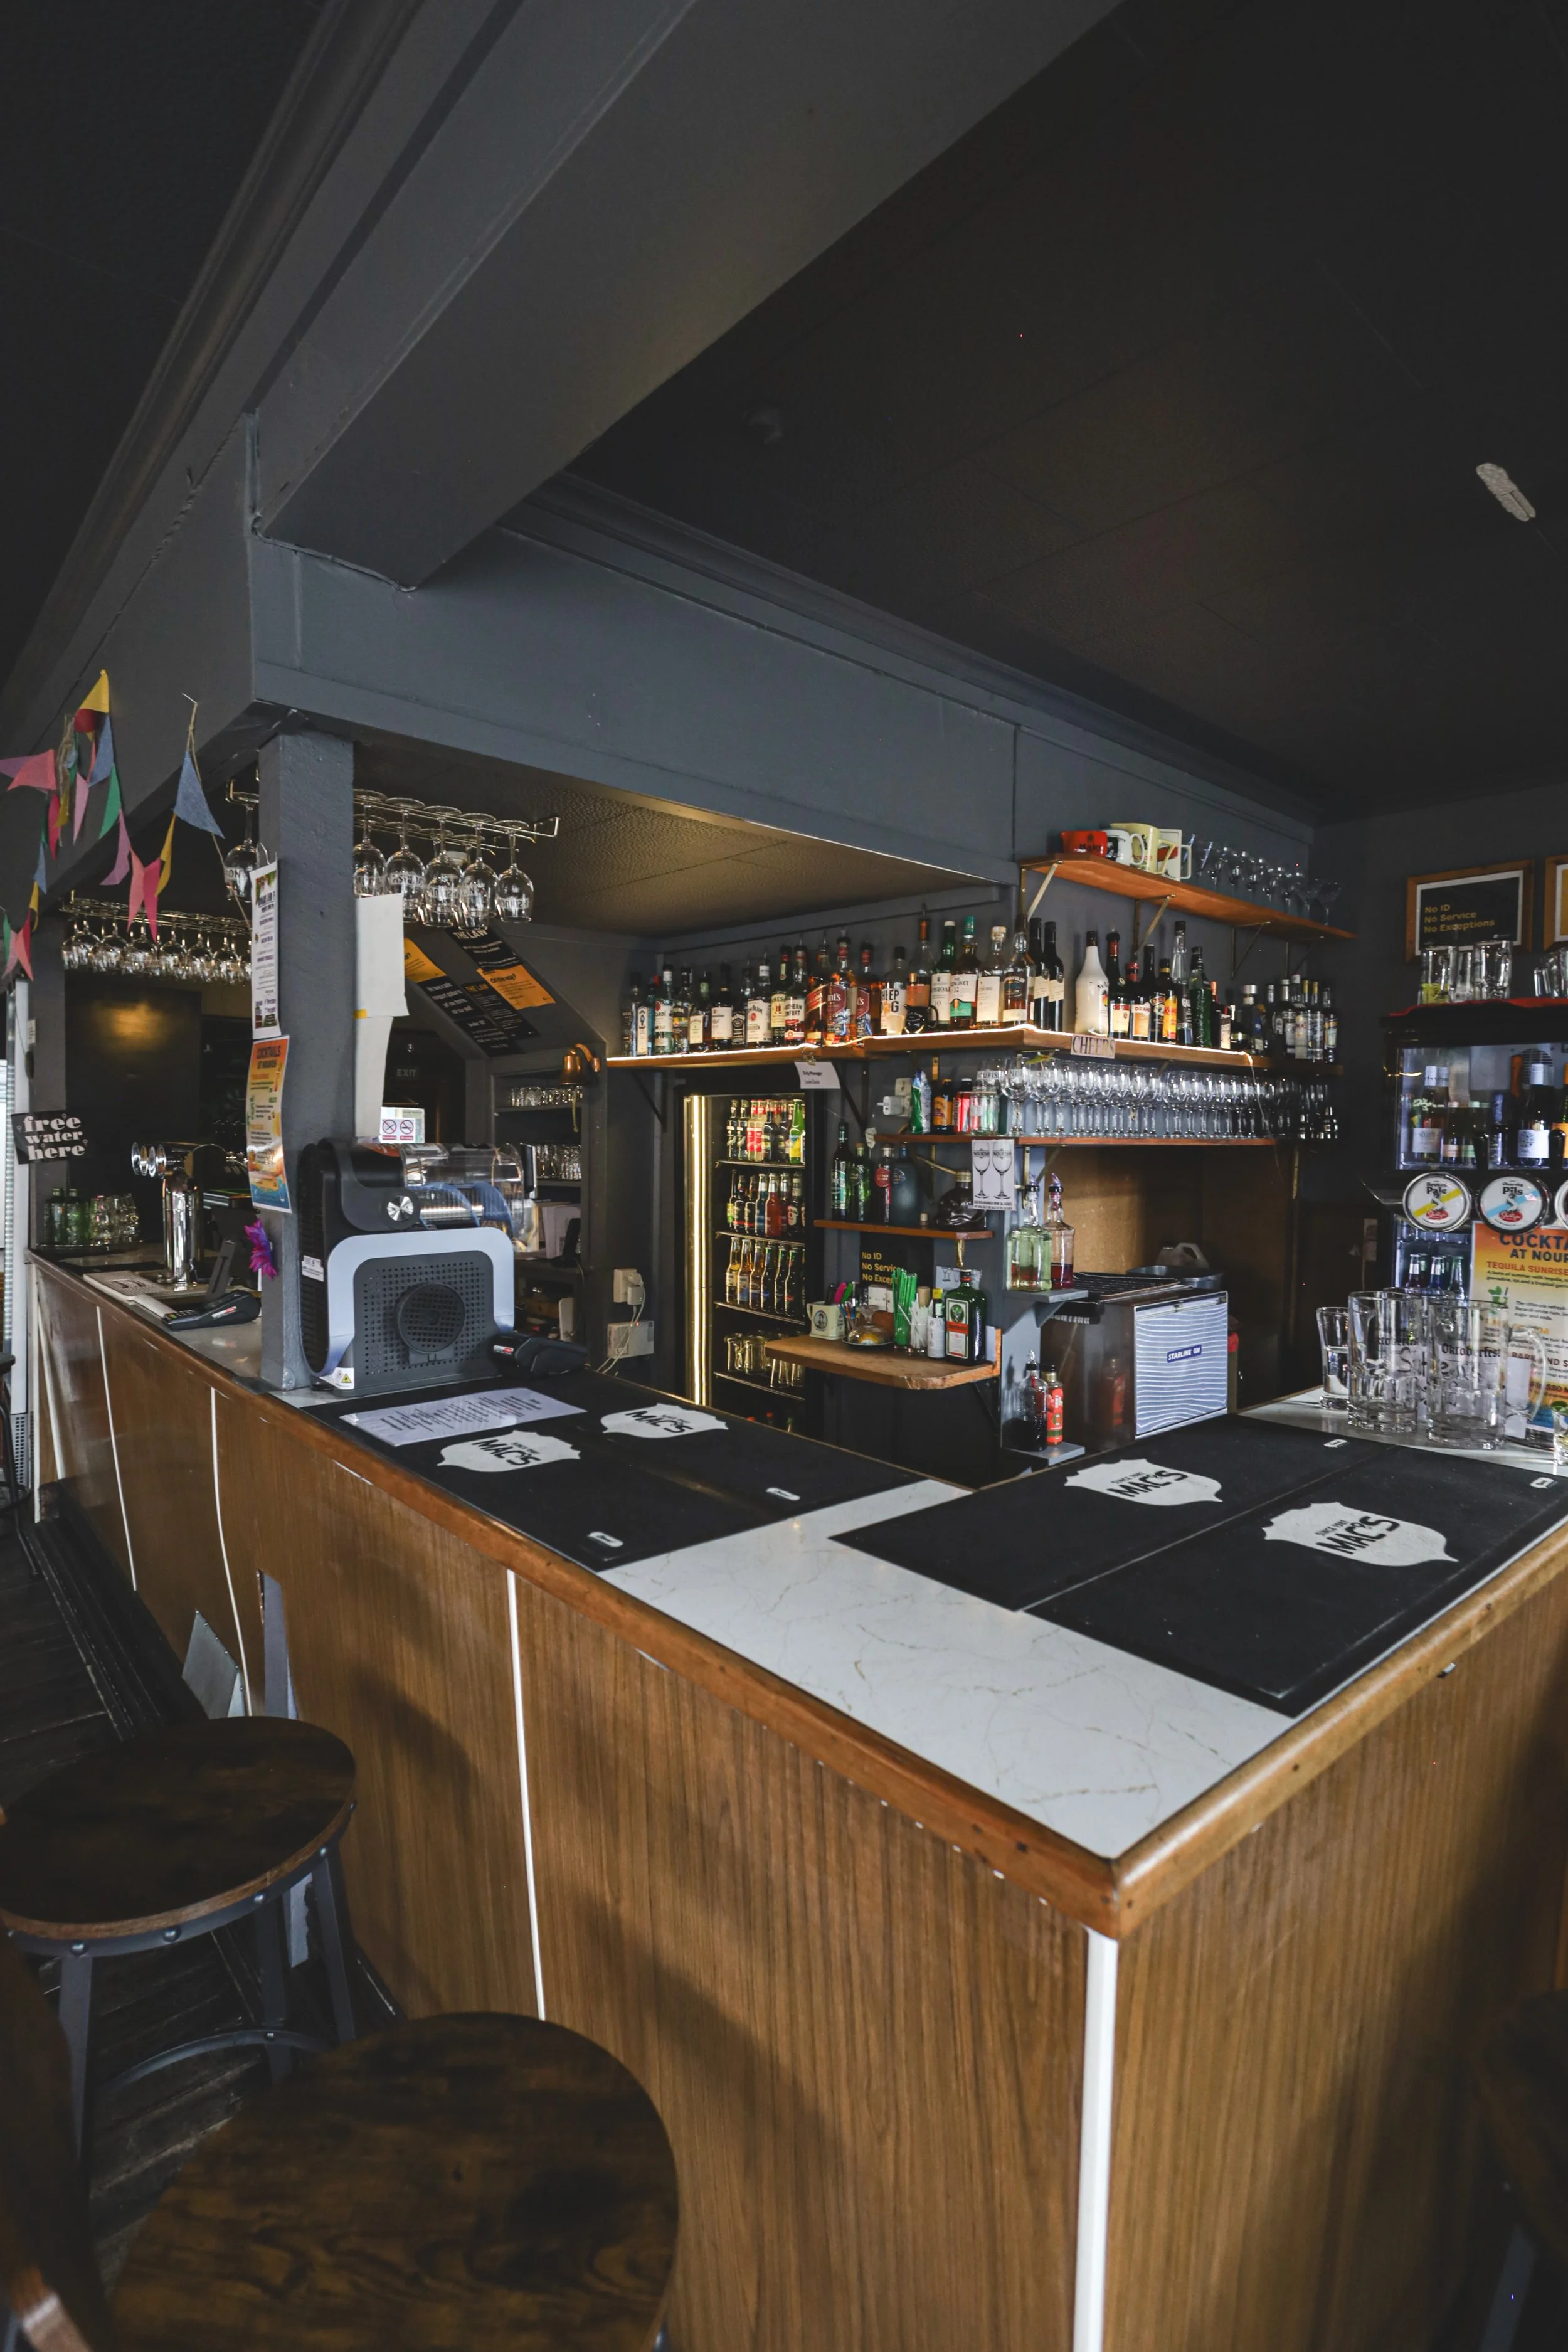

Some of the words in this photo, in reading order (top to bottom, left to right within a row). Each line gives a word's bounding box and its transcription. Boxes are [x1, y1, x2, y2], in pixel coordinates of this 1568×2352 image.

[1440, 912, 1477, 921] Service
[1439, 920, 1495, 931] Exceptions
[466, 930, 488, 938] LAW
[1073, 1035, 1115, 1057] CHEERS
[397, 1069, 416, 1077] EXIT
[23, 1116, 81, 1133] free
[25, 1131, 83, 1144] water
[27, 1145, 85, 1160] here
[1427, 1187, 1447, 1195] Pale
[1503, 1187, 1523, 1195] Pils
[873, 1252, 882, 1260] ID
[1510, 1249, 1527, 1259] AT
[1486, 1261, 1526, 1272] TEQUILA
[1528, 1265, 1568, 1276] SUNRISE
[862, 1273, 873, 1281] No
[1168, 1349, 1192, 1360] STARLINE
[471, 1439, 541, 1466] MAC'S
[1106, 1470, 1189, 1498] MAC'S
[1315, 1516, 1401, 1555] MAC'S
